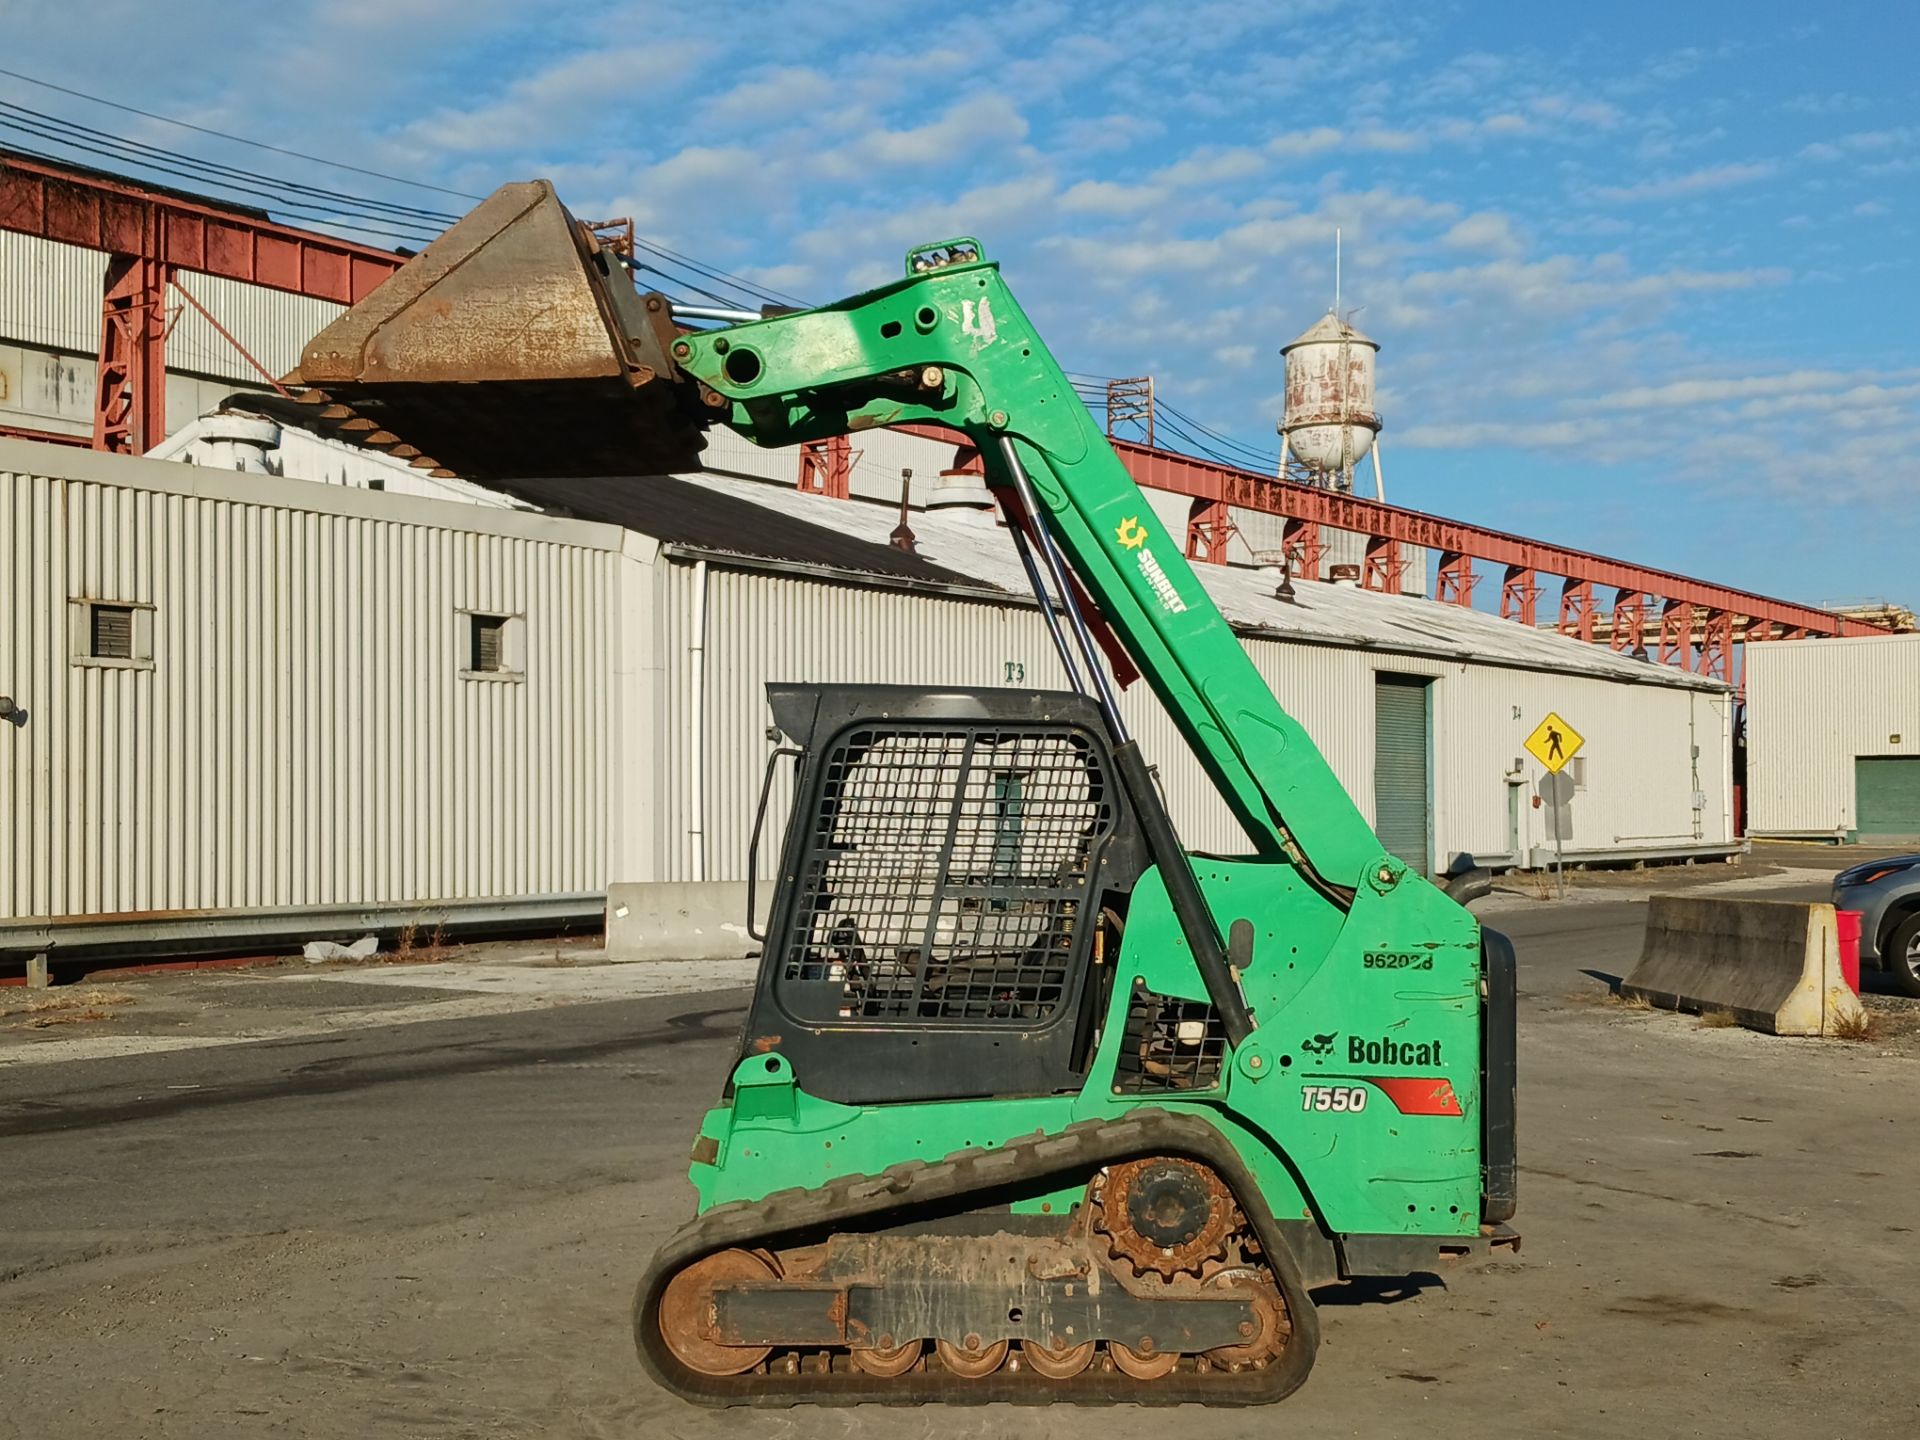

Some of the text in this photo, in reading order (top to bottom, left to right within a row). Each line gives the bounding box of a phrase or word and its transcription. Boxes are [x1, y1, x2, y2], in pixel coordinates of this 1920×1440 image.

[1137, 548, 1187, 614] SUNBELT
[1004, 661, 1025, 684] T3
[1347, 1035, 1442, 1067] Bobcat
[1301, 1085, 1368, 1113] T550
